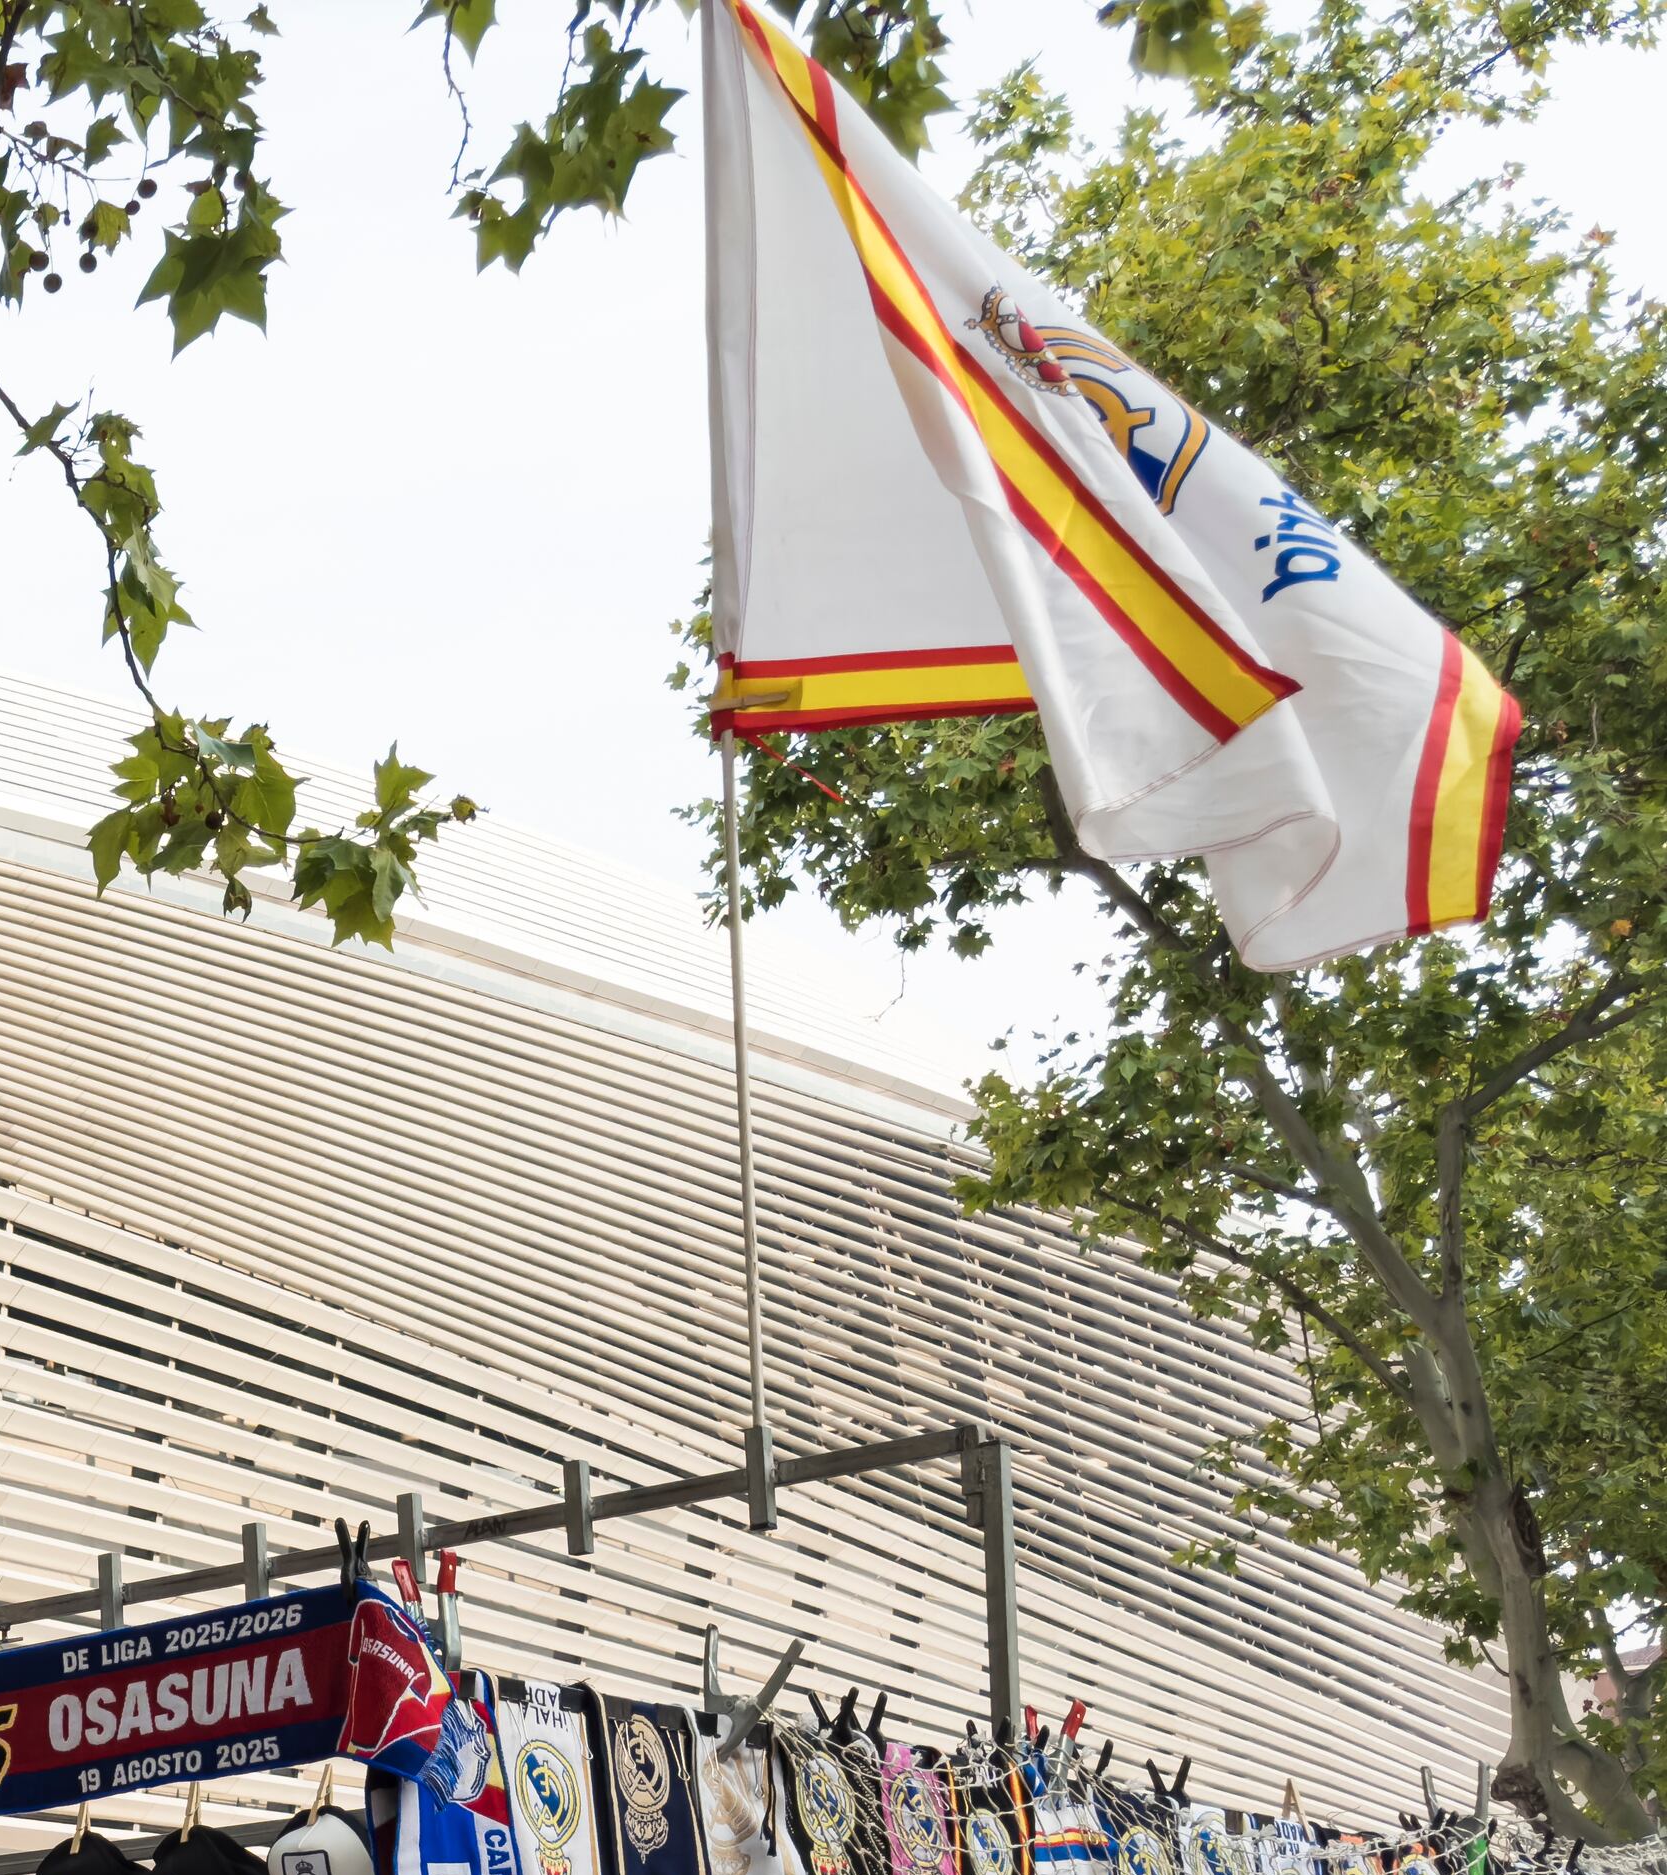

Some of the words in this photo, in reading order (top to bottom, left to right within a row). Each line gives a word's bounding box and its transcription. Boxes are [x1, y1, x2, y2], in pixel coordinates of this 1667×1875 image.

[63, 1650, 90, 1674] DE
[101, 1635, 153, 1668] LIGA
[166, 1603, 303, 1655] 2025/2026
[361, 1636, 417, 1682] OSASUNA
[48, 1647, 313, 1752] OSASUNA
[78, 1769, 102, 1794] 19
[112, 1750, 203, 1788] AGOSTO
[216, 1736, 280, 1771] 2025
